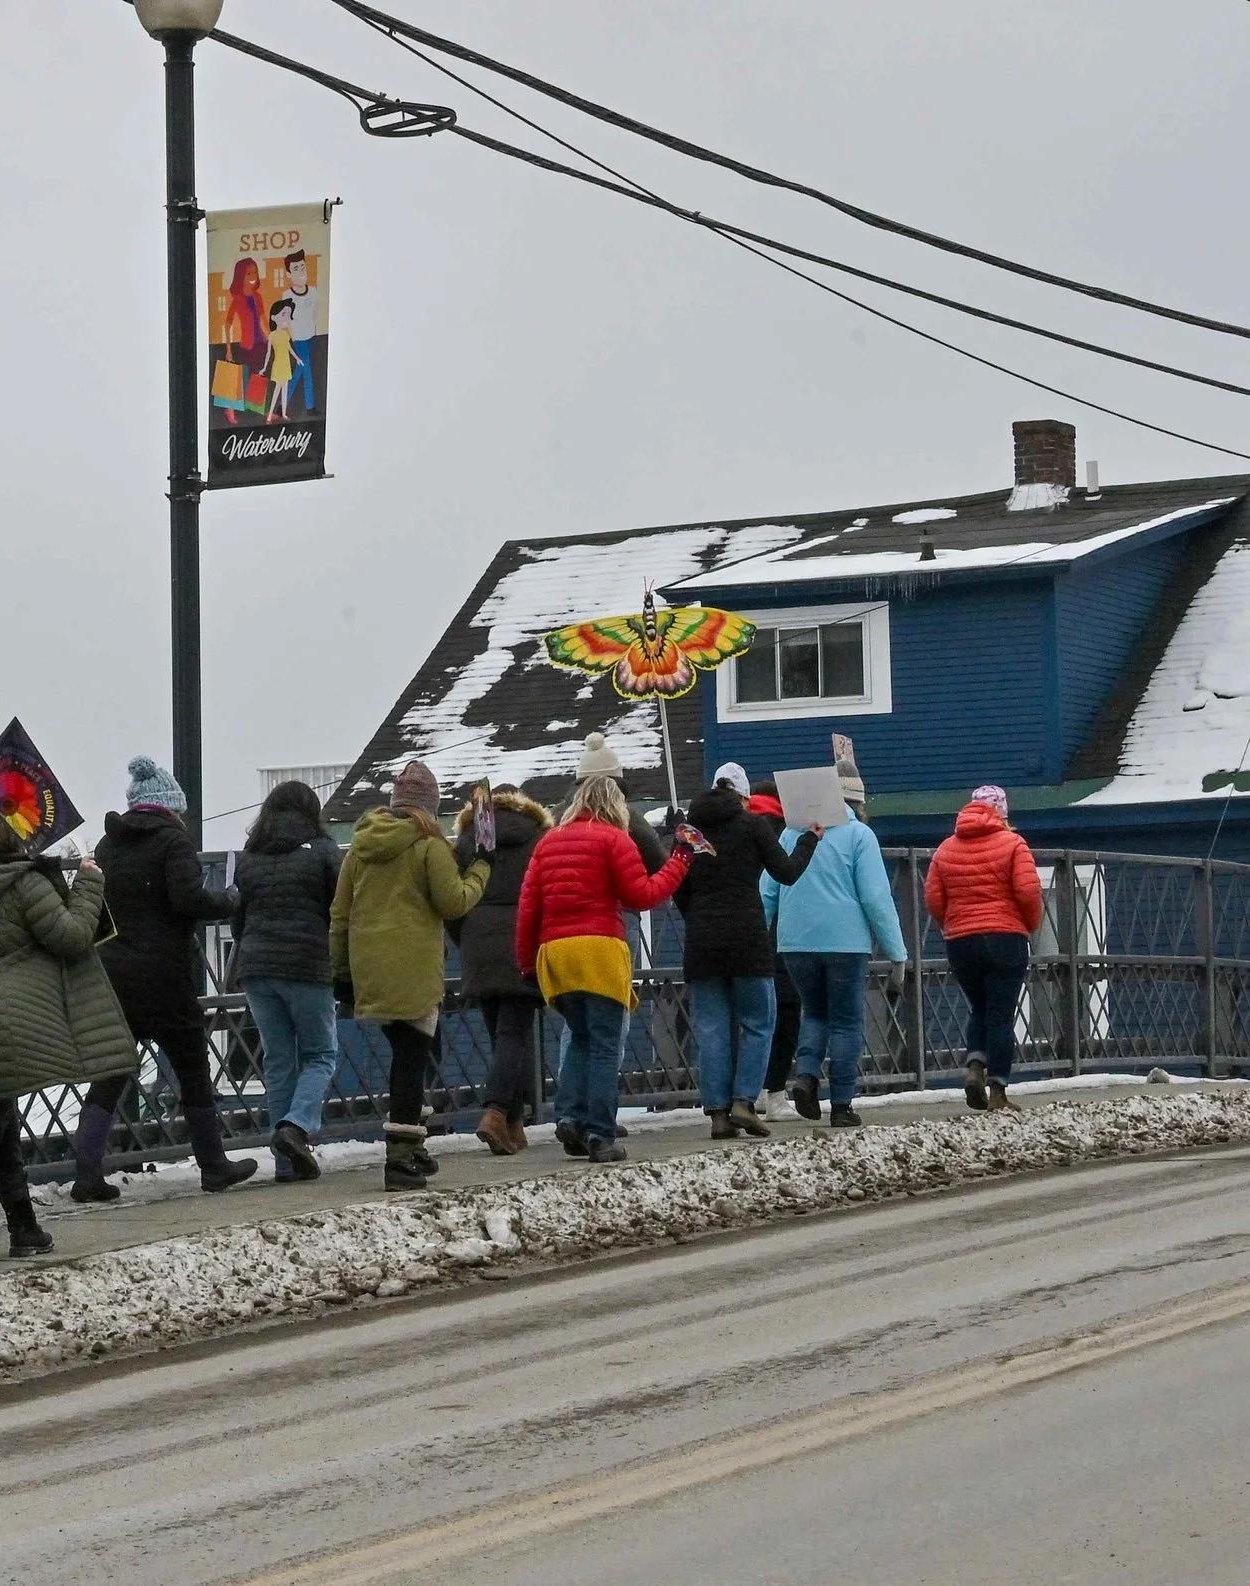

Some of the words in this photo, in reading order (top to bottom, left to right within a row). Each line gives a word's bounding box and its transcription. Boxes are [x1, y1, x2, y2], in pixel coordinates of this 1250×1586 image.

[239, 231, 301, 252] SHOP
[222, 427, 313, 461] Waterbury
[42, 789, 56, 828] EQUALITY
